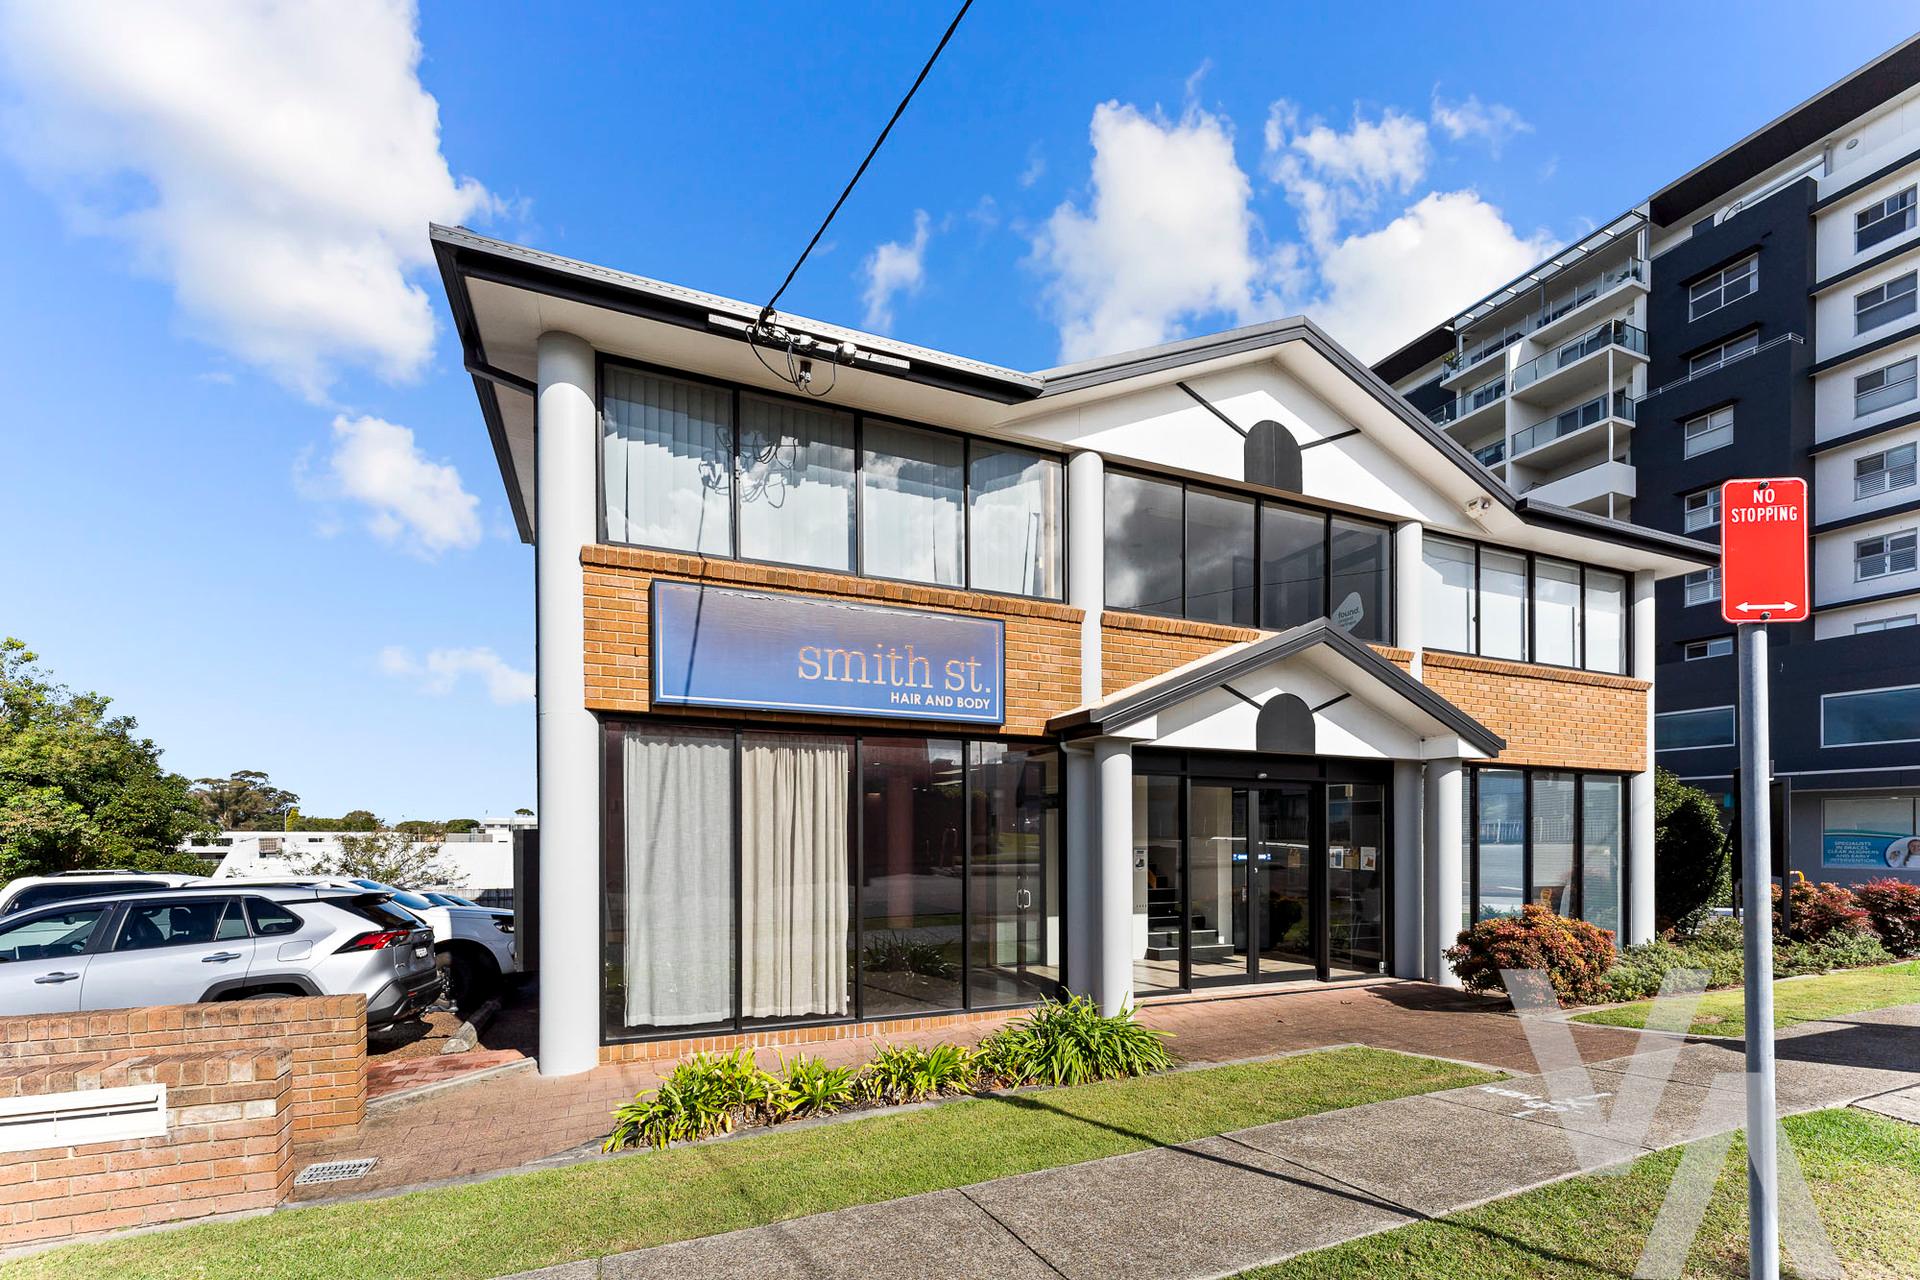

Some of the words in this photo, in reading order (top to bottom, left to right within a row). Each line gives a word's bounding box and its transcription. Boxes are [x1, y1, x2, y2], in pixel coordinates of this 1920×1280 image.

[1753, 488, 1775, 503] NO
[1731, 506, 1798, 522] STOPPING
[798, 643, 934, 689] smith
[945, 656, 991, 693] st.
[890, 691, 921, 705] HAIR
[925, 695, 954, 707] AND
[957, 697, 991, 710] BODY
